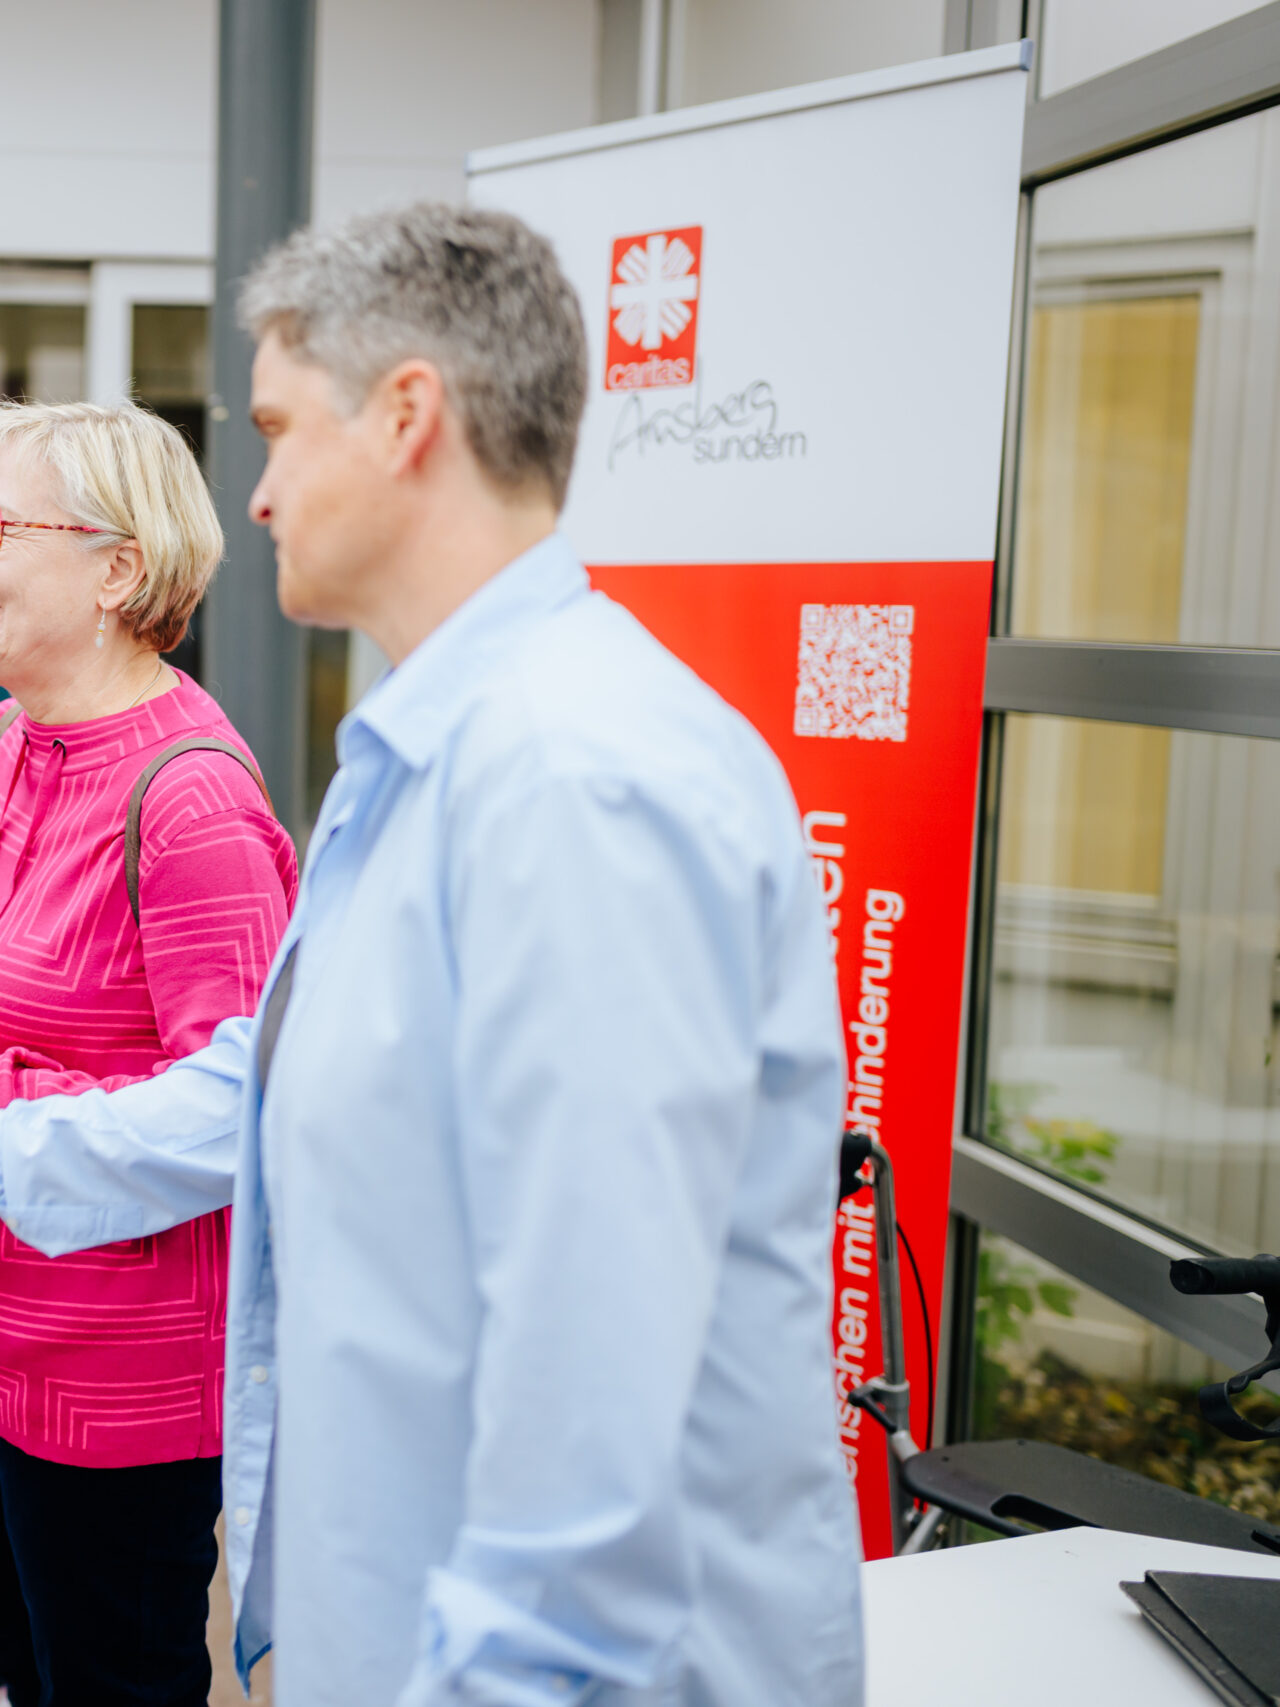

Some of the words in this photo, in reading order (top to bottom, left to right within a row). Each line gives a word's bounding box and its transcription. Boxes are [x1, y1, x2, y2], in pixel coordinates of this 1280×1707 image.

[607, 354, 691, 389] caritas
[693, 428, 807, 464] sundern
[844, 888, 905, 1184] hinderung
[837, 1198, 876, 1278] mit
[832, 1286, 869, 1486] enschen
